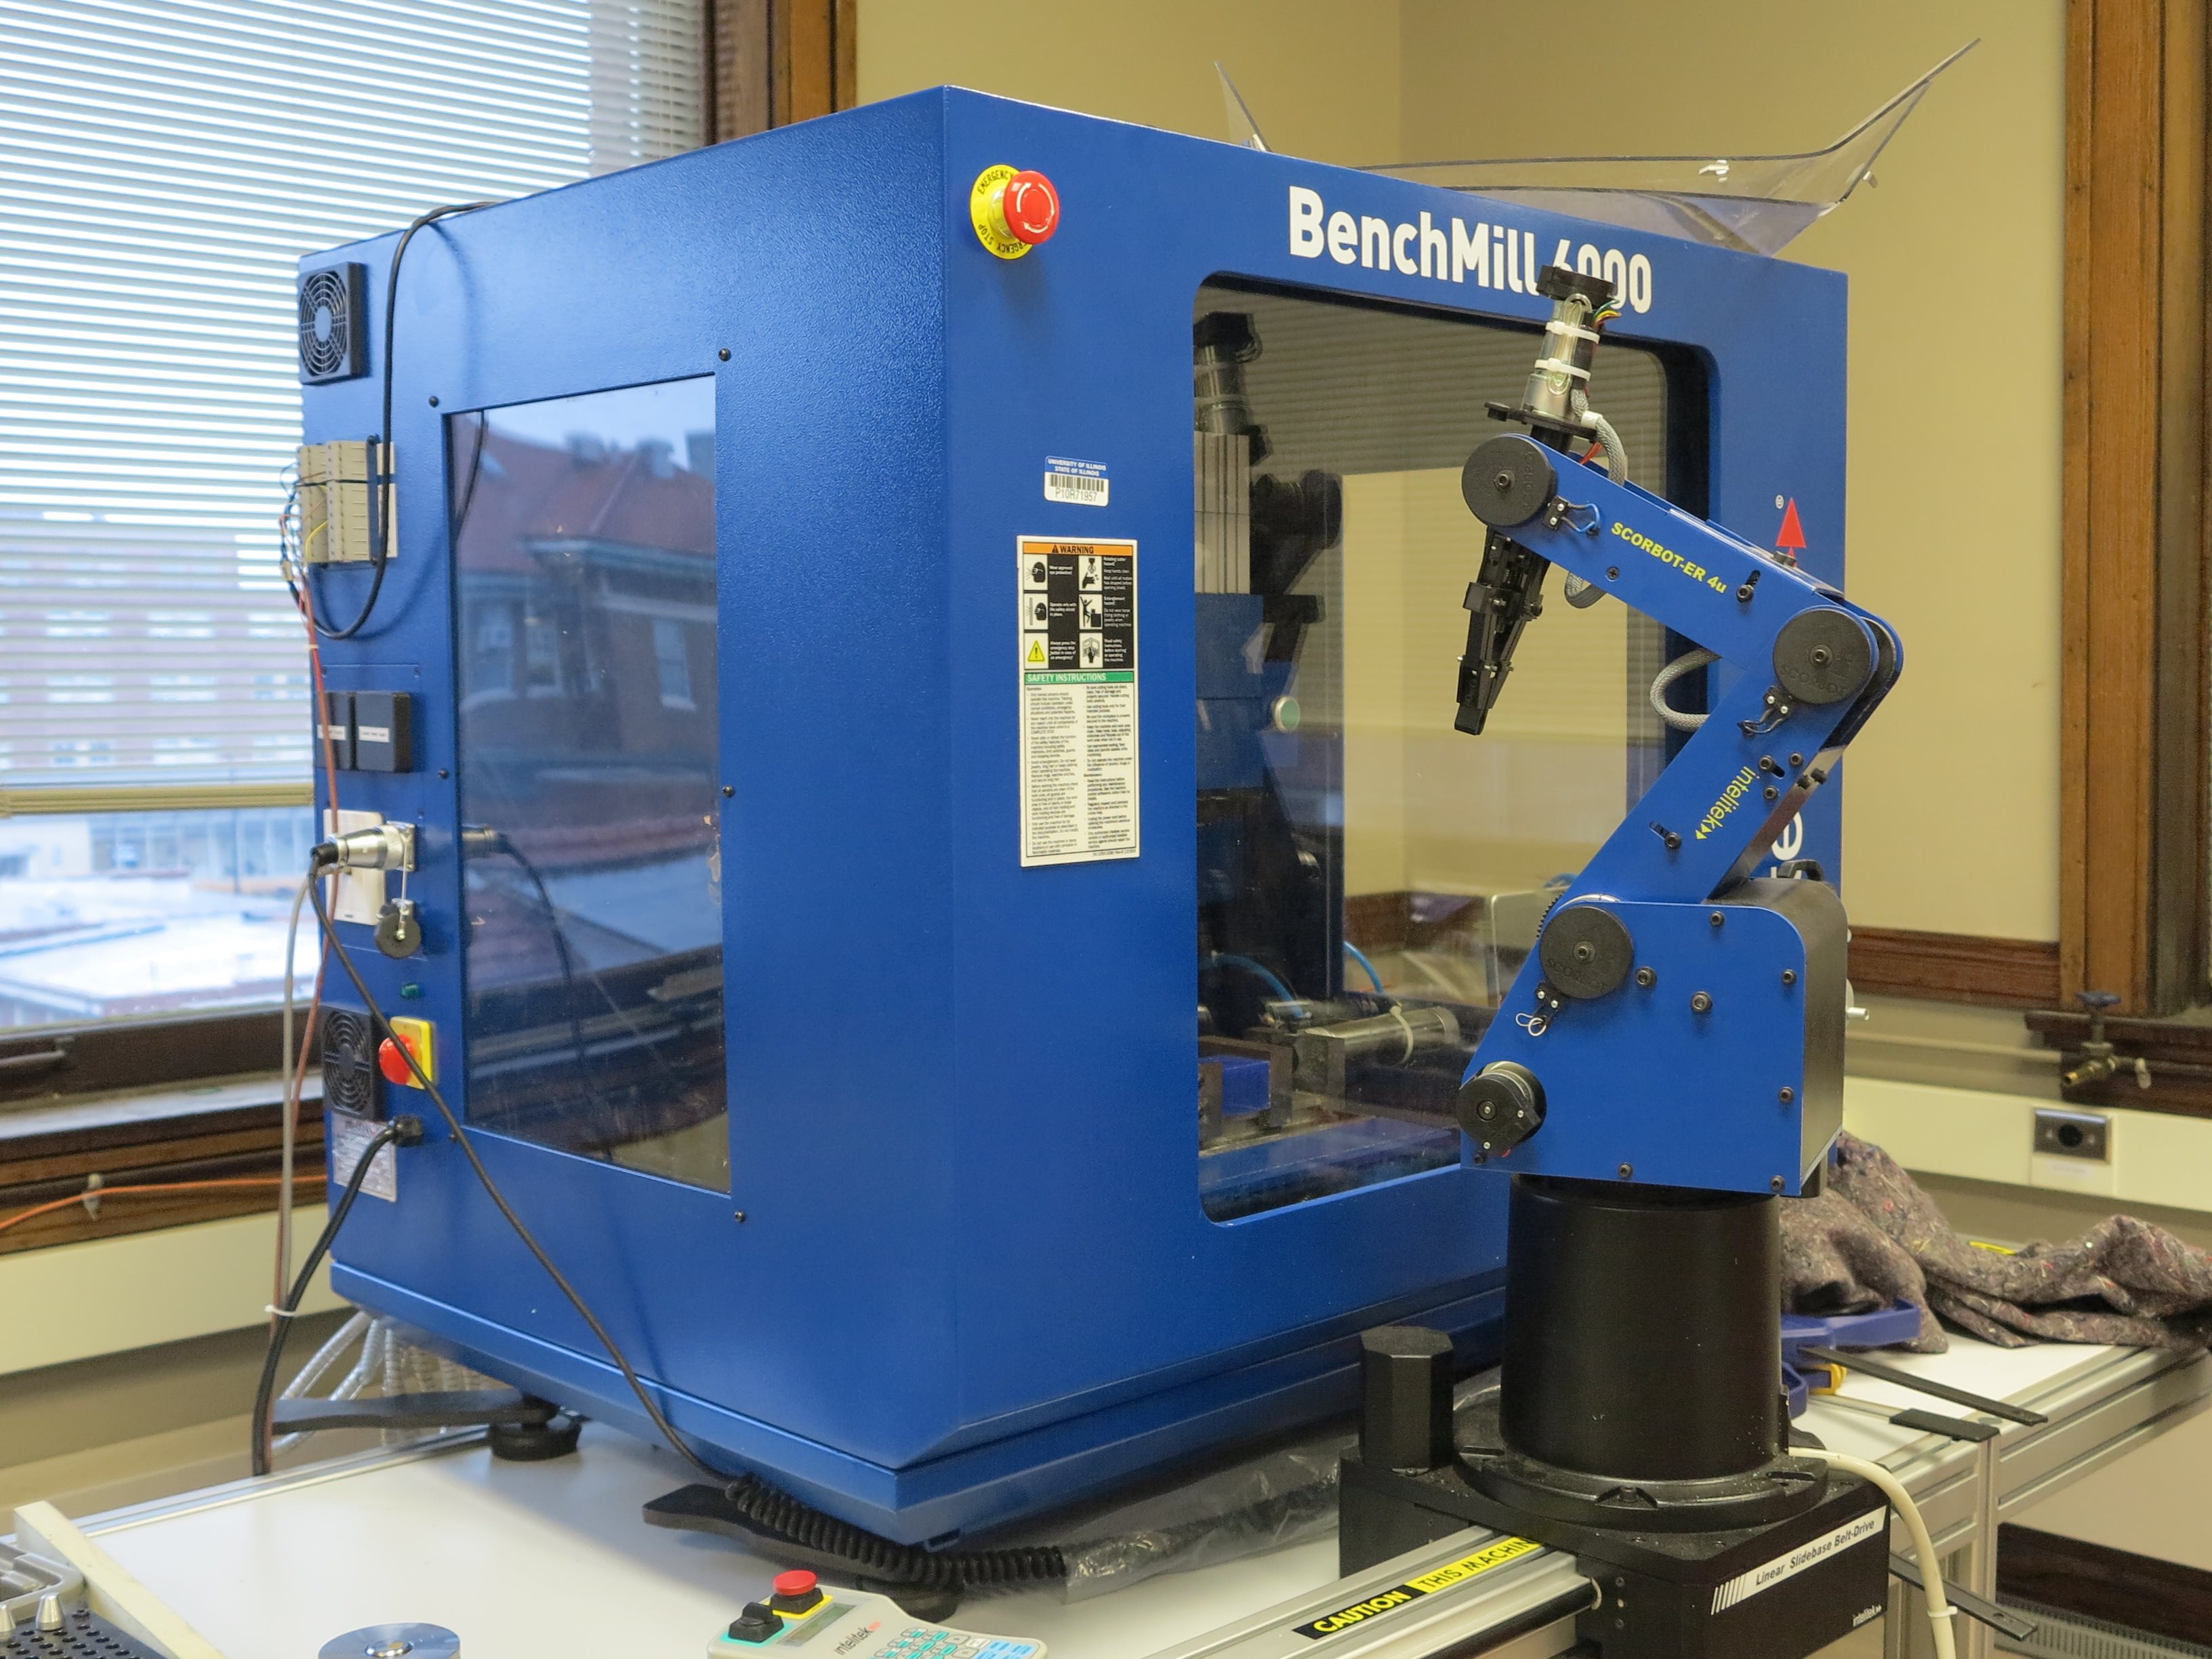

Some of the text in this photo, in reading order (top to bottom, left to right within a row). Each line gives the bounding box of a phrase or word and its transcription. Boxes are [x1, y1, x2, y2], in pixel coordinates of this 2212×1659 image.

[977, 169, 1015, 195] EMERGENCY
[978, 224, 994, 245] STOP
[1289, 185, 1540, 296] BenchMill
[1060, 545, 1094, 554] WARNING
[1611, 522, 1727, 594] SCORBOT-ER 4u
[1026, 672, 1107, 682] SAFETY INSTRUCTIONS
[1702, 766, 1760, 830] intelitek
[1755, 1519, 1875, 1586] Linear Slidebase Belt-Drive
[1313, 1537, 1536, 1633] CAUTION THIS MACHIN
